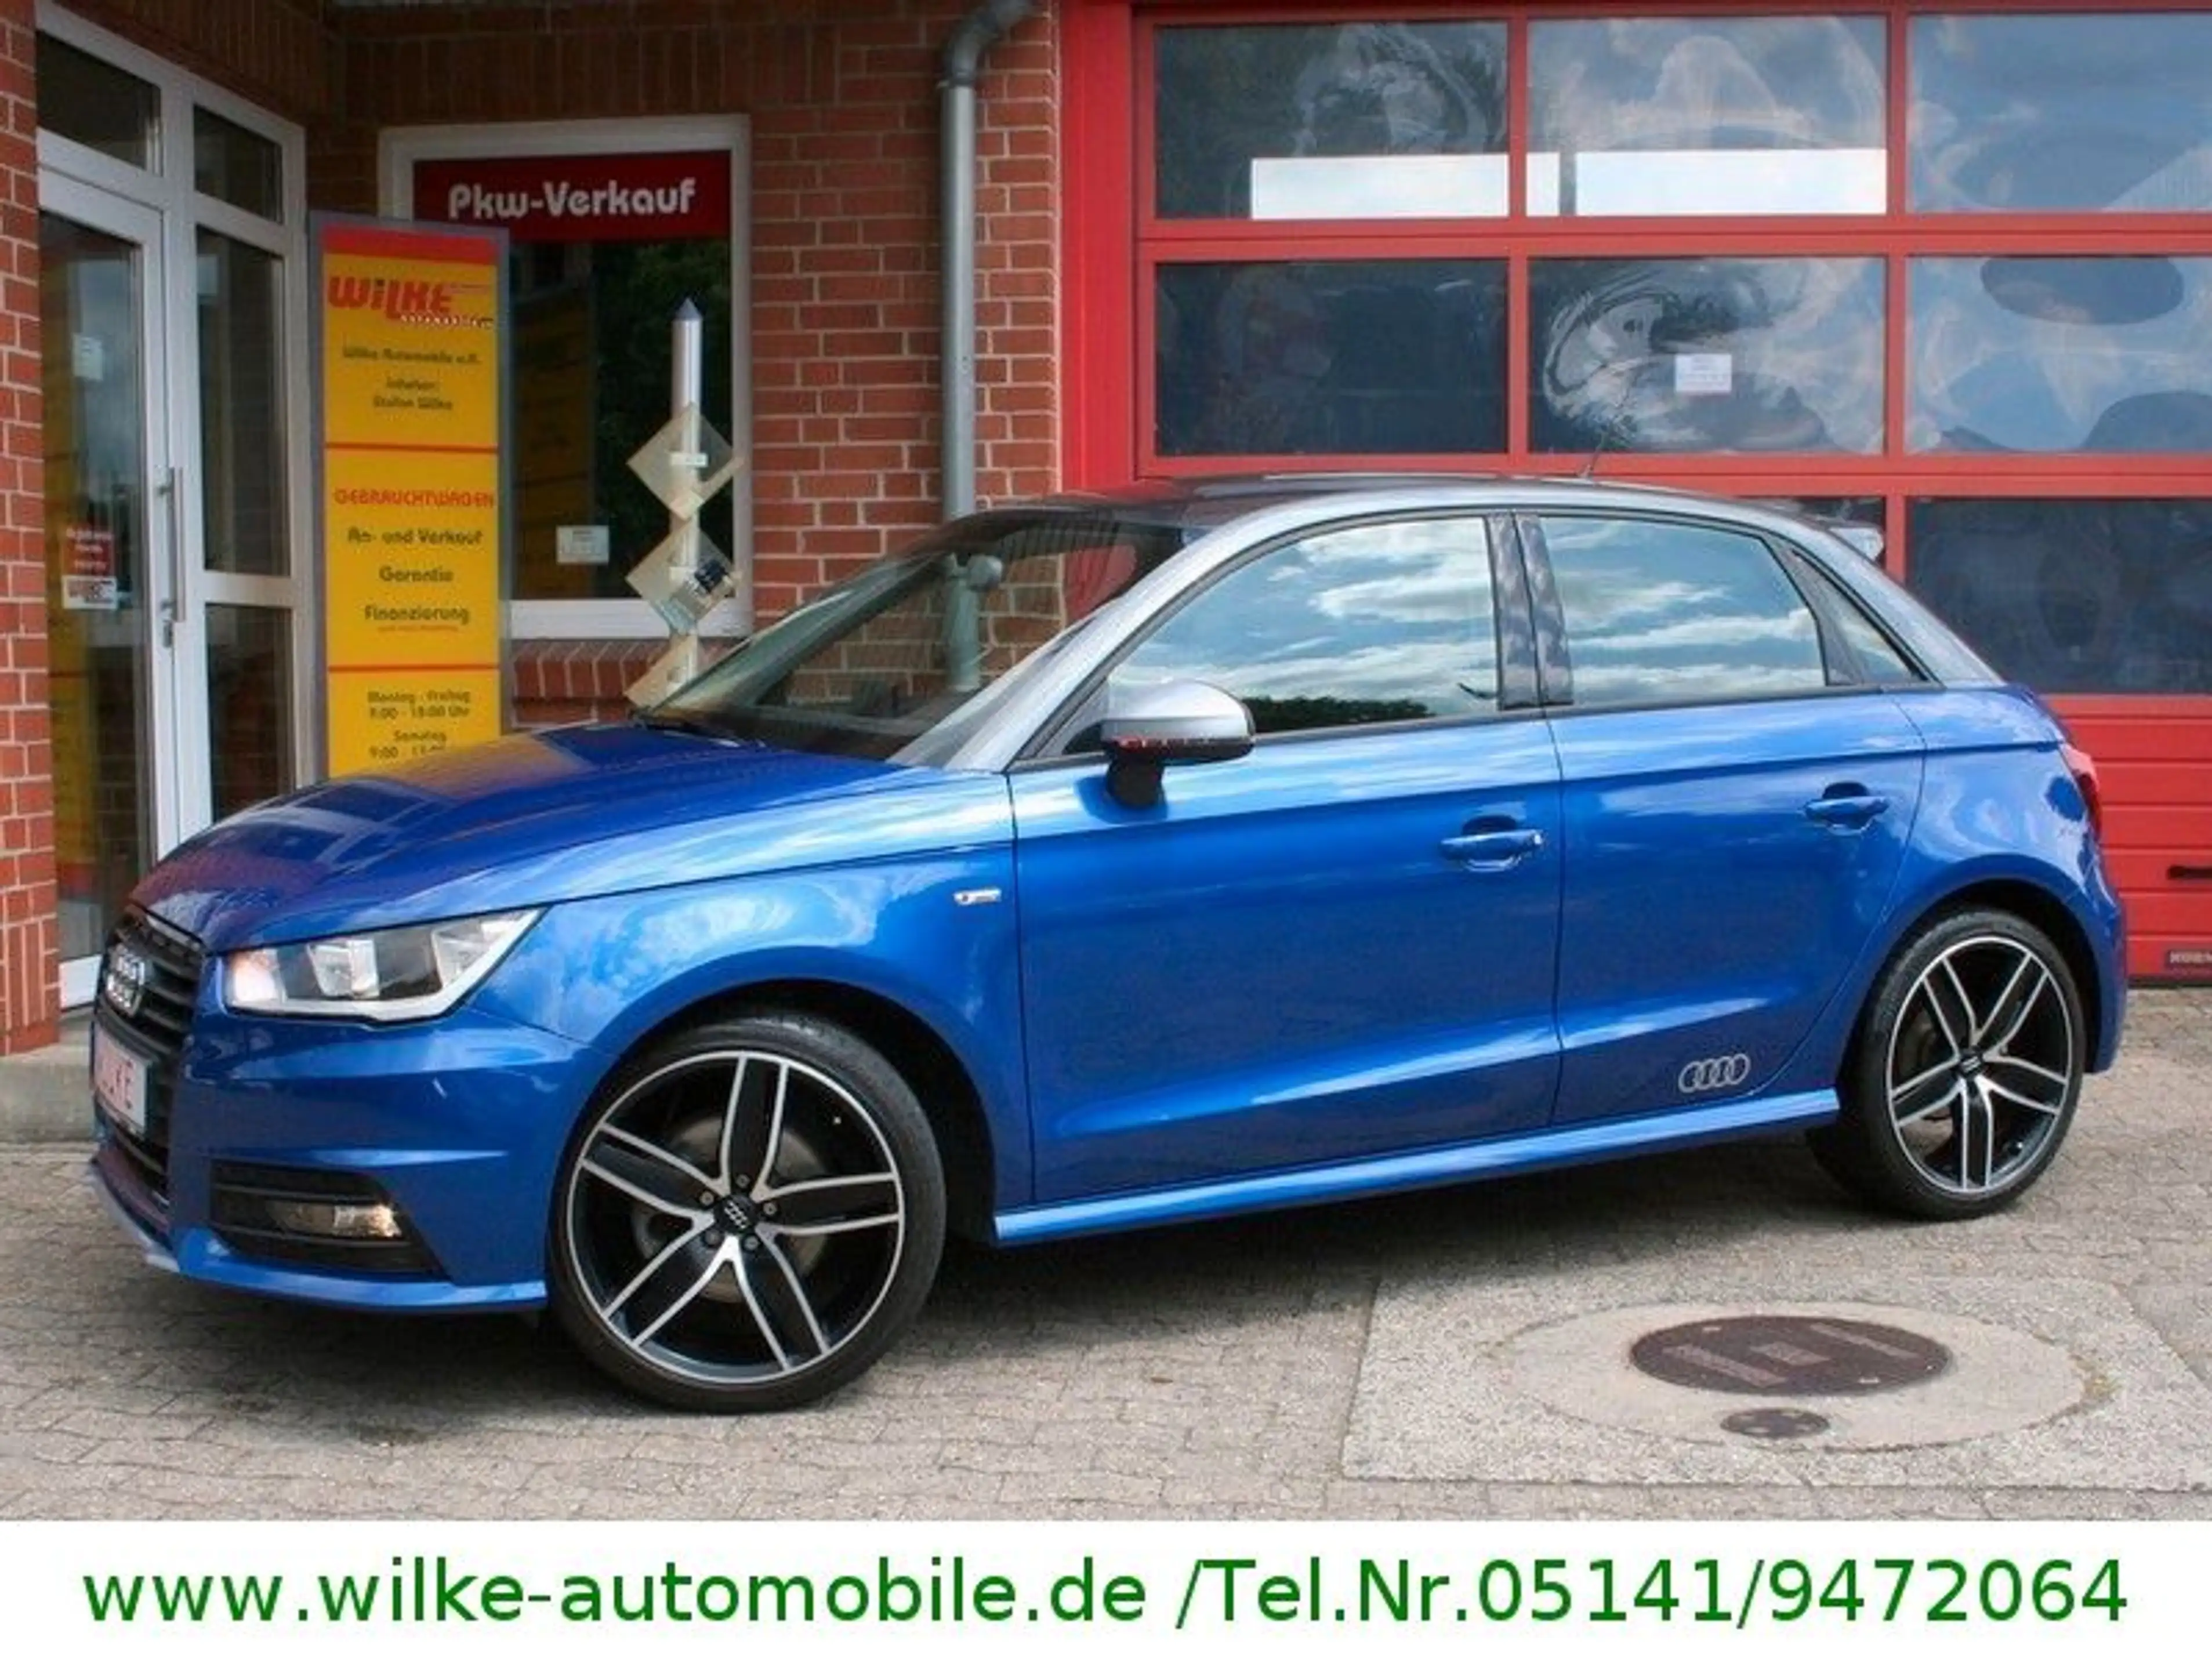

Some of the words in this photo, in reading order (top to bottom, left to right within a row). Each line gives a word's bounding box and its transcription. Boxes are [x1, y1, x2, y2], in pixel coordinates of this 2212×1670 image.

[448, 177, 696, 219] Pkw-Verkauf
[418, 528, 484, 544] Verkauf
[379, 565, 454, 582] Garantie
[365, 604, 470, 625] Finanzierung
